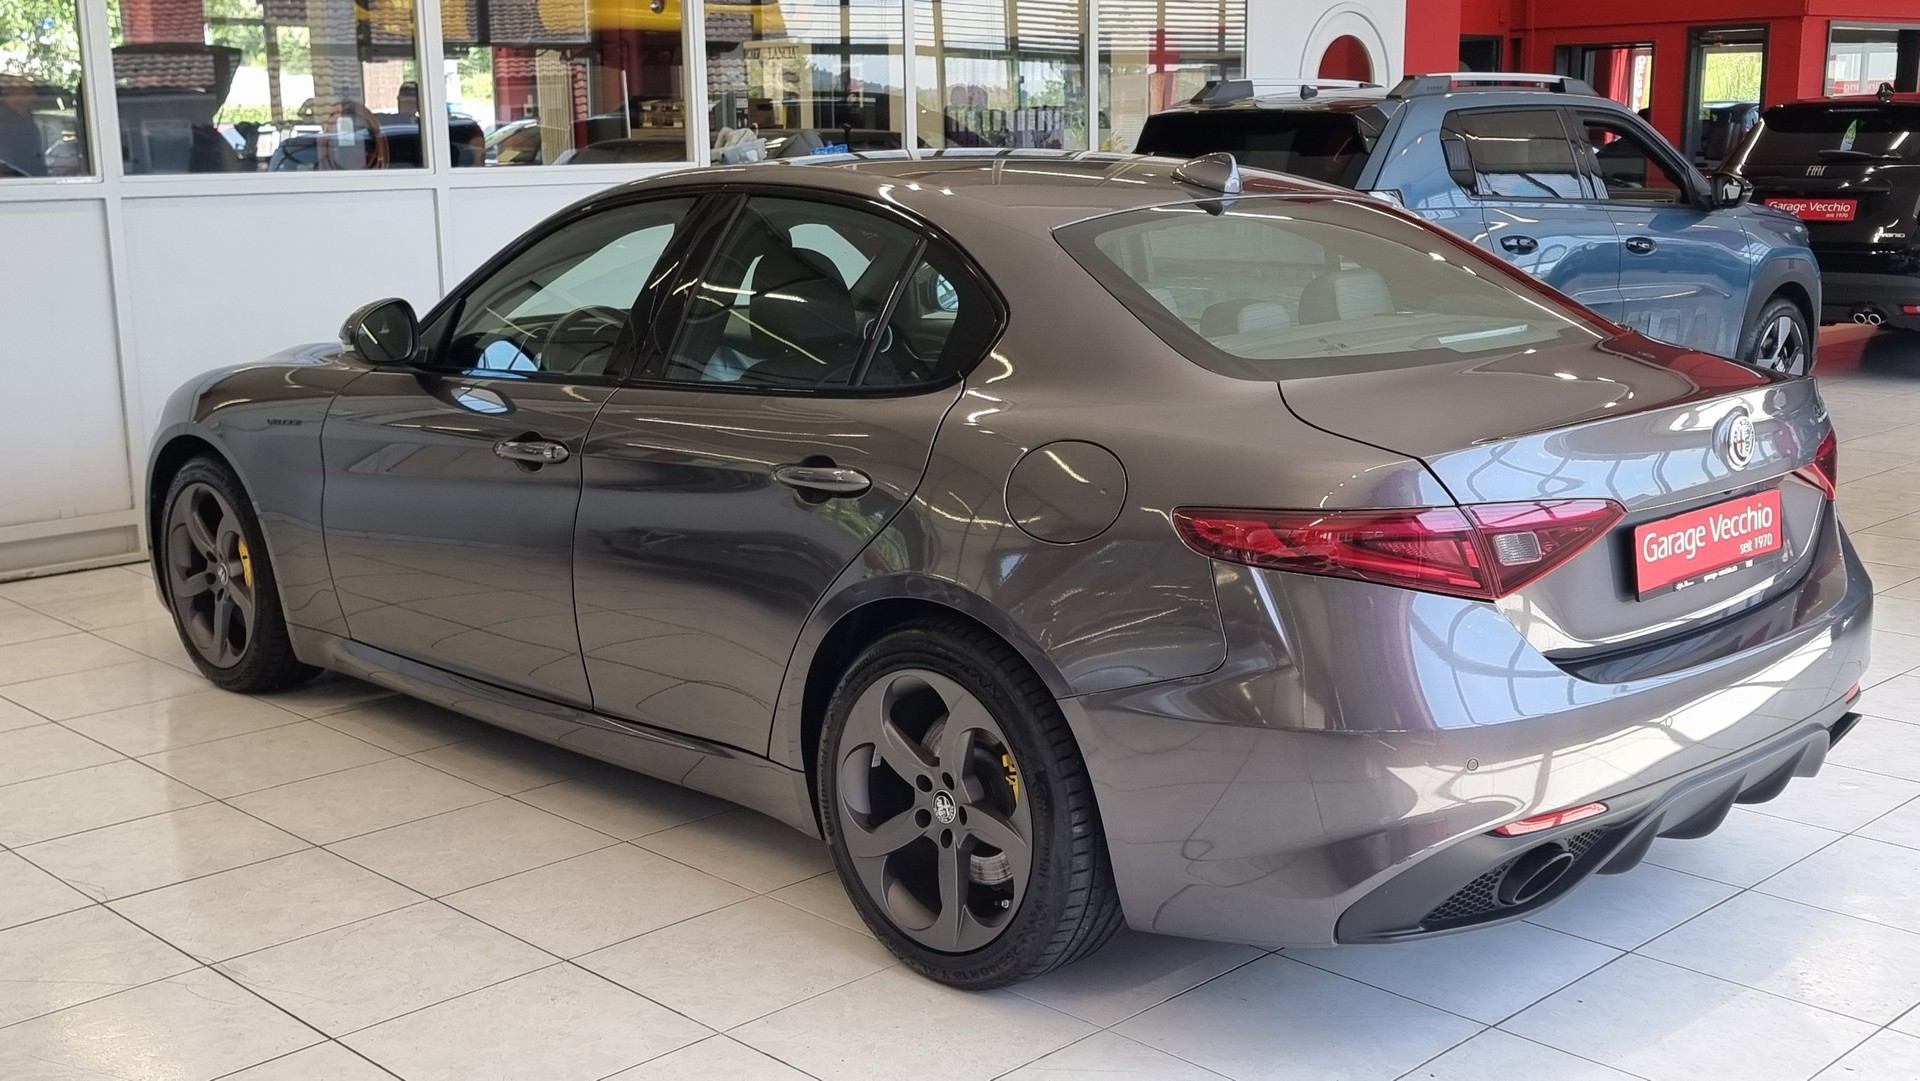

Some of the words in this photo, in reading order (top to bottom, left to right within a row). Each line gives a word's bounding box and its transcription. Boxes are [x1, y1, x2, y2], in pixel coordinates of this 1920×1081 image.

[1806, 165, 1828, 176] FIAT
[1769, 201, 1807, 214] Garage
[1809, 202, 1851, 213] Vecchio
[1643, 525, 1706, 562] Garage
[1709, 503, 1773, 543] Vecchio
[1740, 539, 1753, 554] seit
[1754, 532, 1773, 551] 1970
